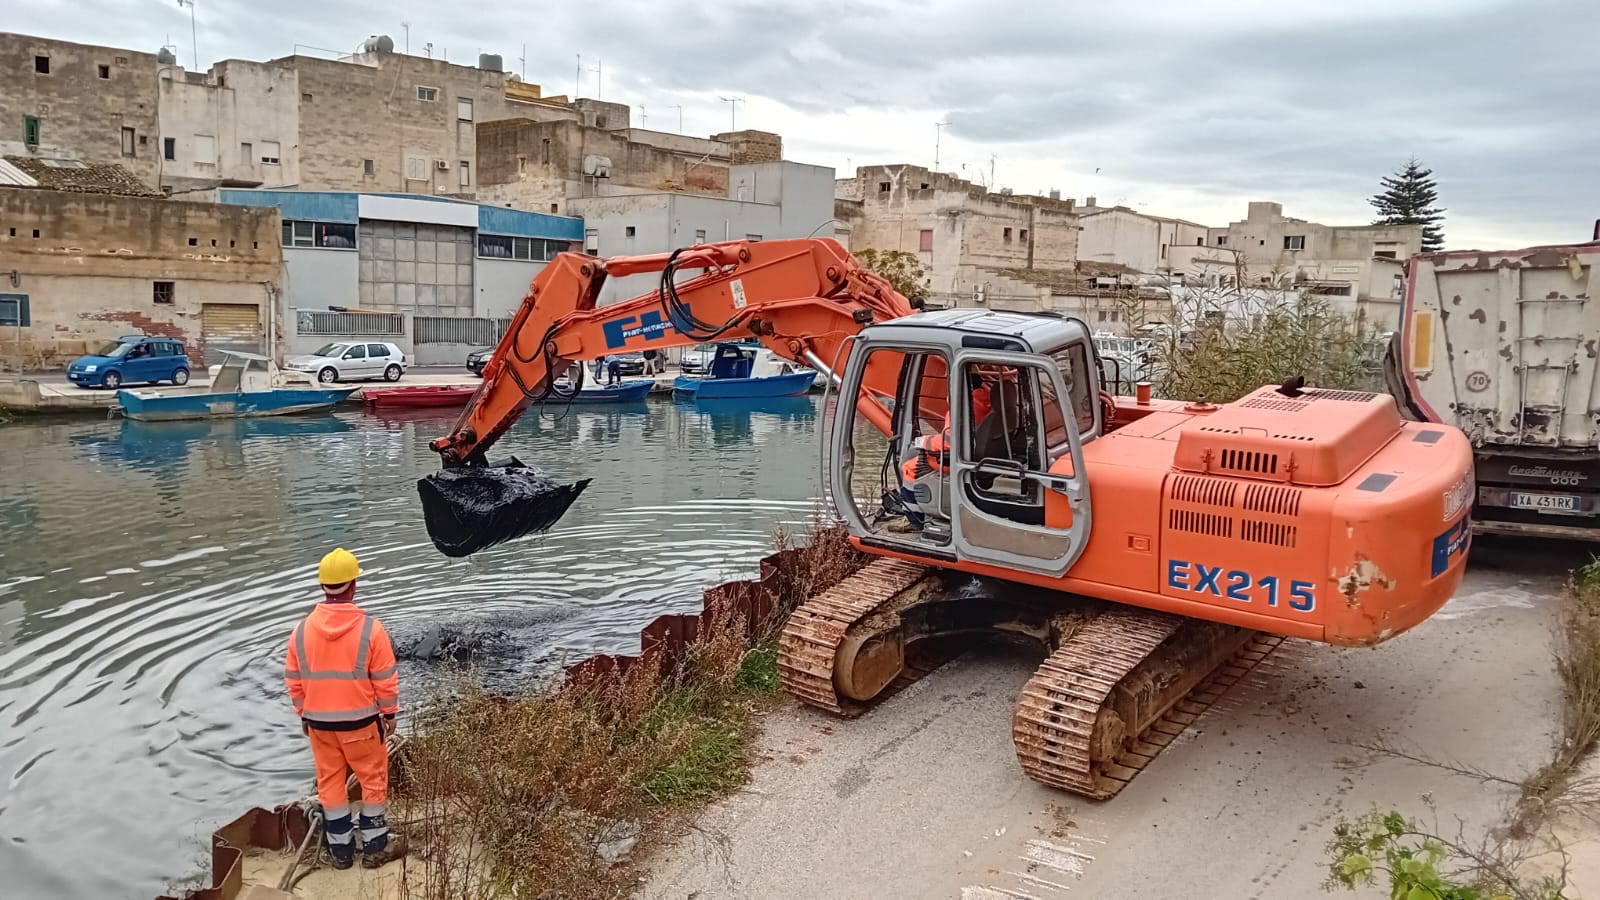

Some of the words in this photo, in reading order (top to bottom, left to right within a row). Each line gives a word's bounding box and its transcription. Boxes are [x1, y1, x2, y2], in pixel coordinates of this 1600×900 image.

[1472, 376, 1485, 386] 70
[1519, 495, 1532, 506] XA
[1168, 559, 1316, 613] EX215
